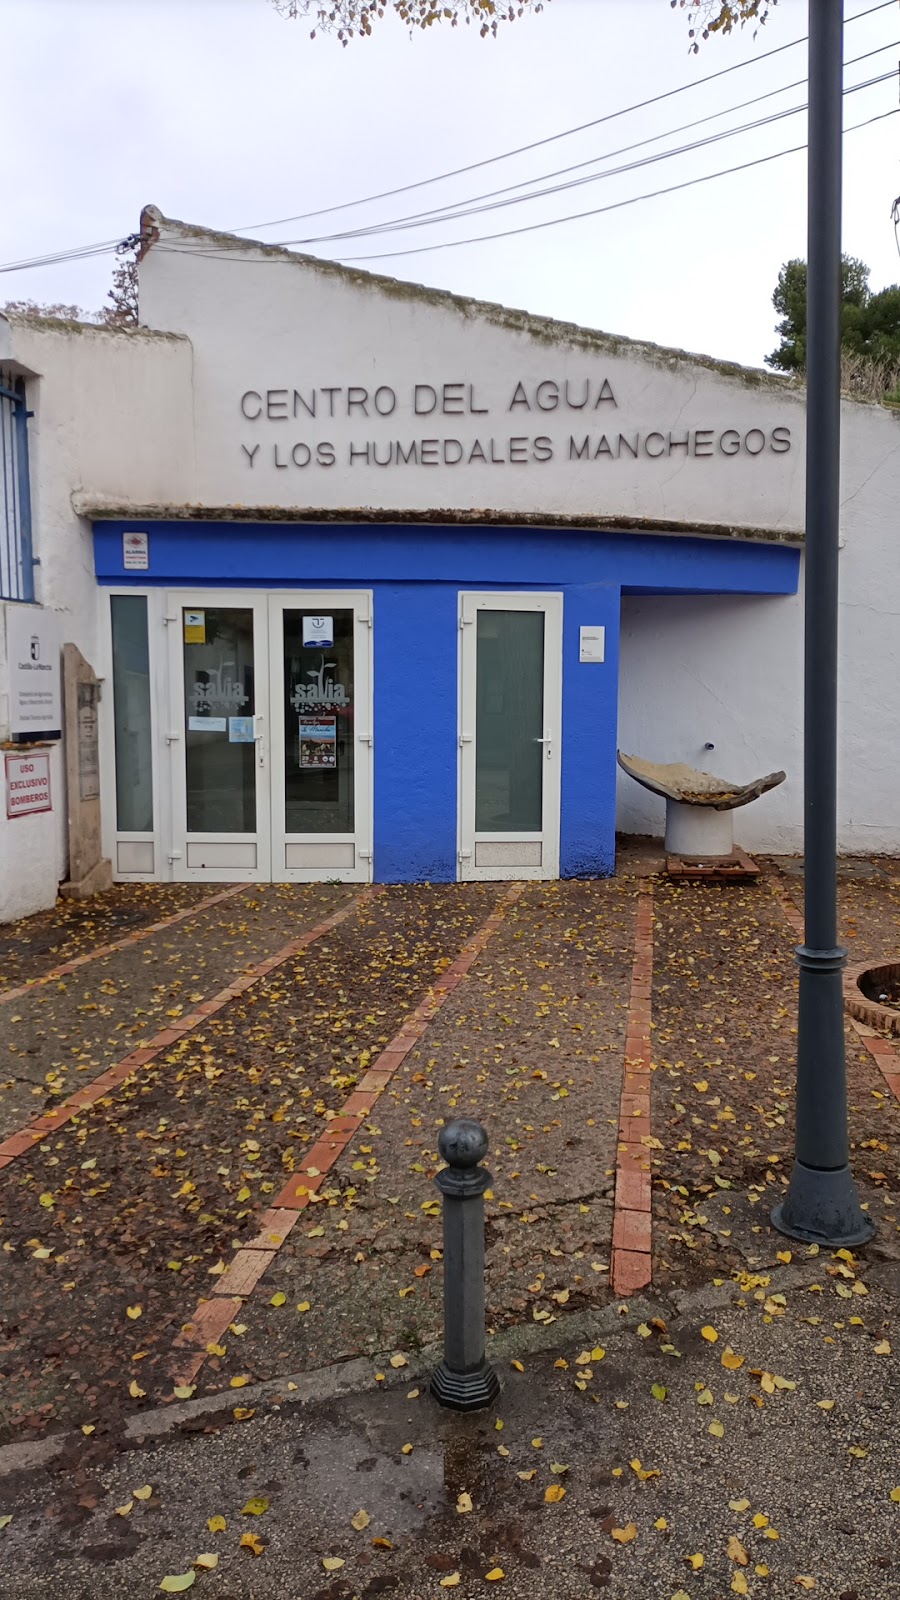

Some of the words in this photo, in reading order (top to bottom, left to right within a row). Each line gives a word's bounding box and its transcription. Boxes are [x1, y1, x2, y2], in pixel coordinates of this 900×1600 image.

[240, 385, 397, 420] CENTRO
[414, 383, 489, 416] DEL
[508, 378, 618, 412] AGUA
[241, 443, 260, 469] Y
[274, 441, 336, 469] LOS
[350, 436, 553, 467] HUMEDALES
[569, 427, 791, 460] MANCHEGOS
[20, 764, 34, 773] USO
[10, 777, 48, 790] EXCLUSIVO
[11, 792, 49, 806] BOMBEROS
